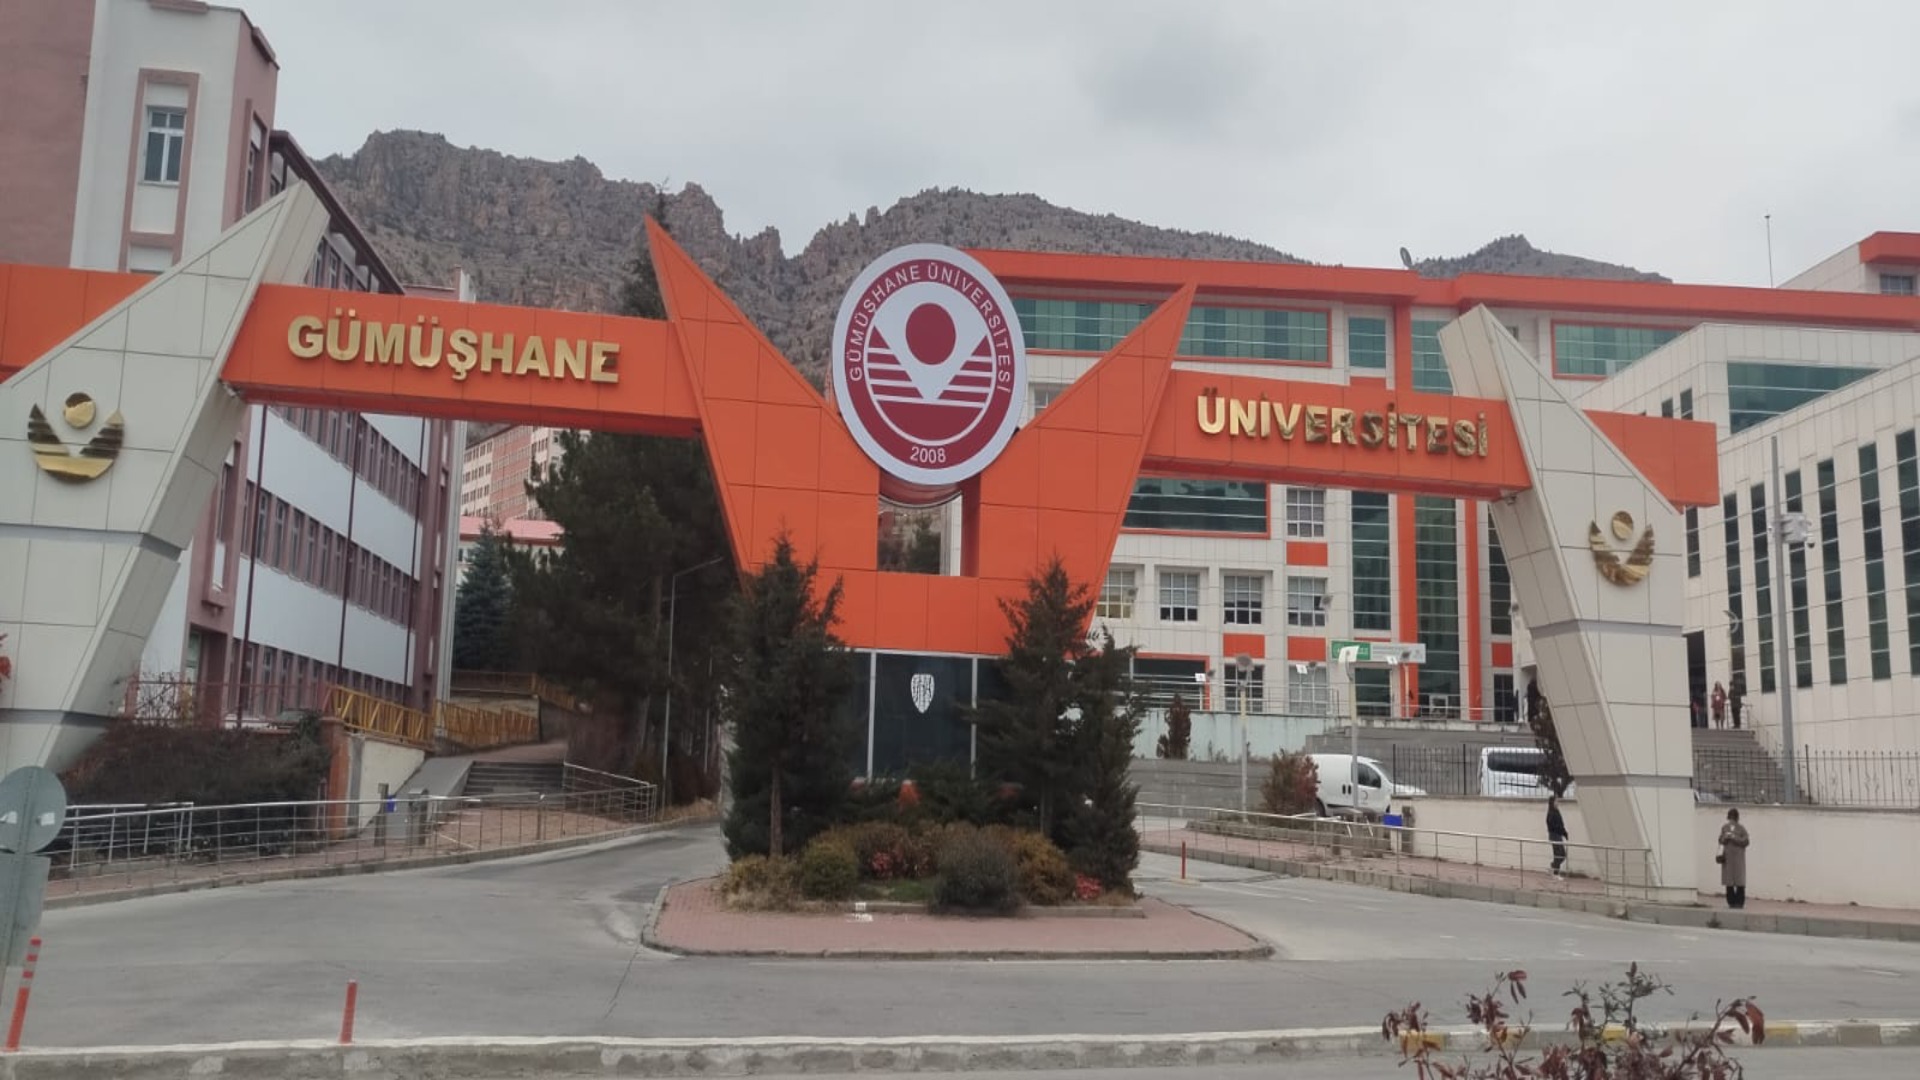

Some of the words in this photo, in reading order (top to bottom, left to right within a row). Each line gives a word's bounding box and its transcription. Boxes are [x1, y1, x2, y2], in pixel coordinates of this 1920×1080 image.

[287, 308, 620, 383] GÜMÜŞHANE
[910, 446, 946, 464] 2008
[1197, 387, 1488, 457] ÜNİVERSİTESİ
